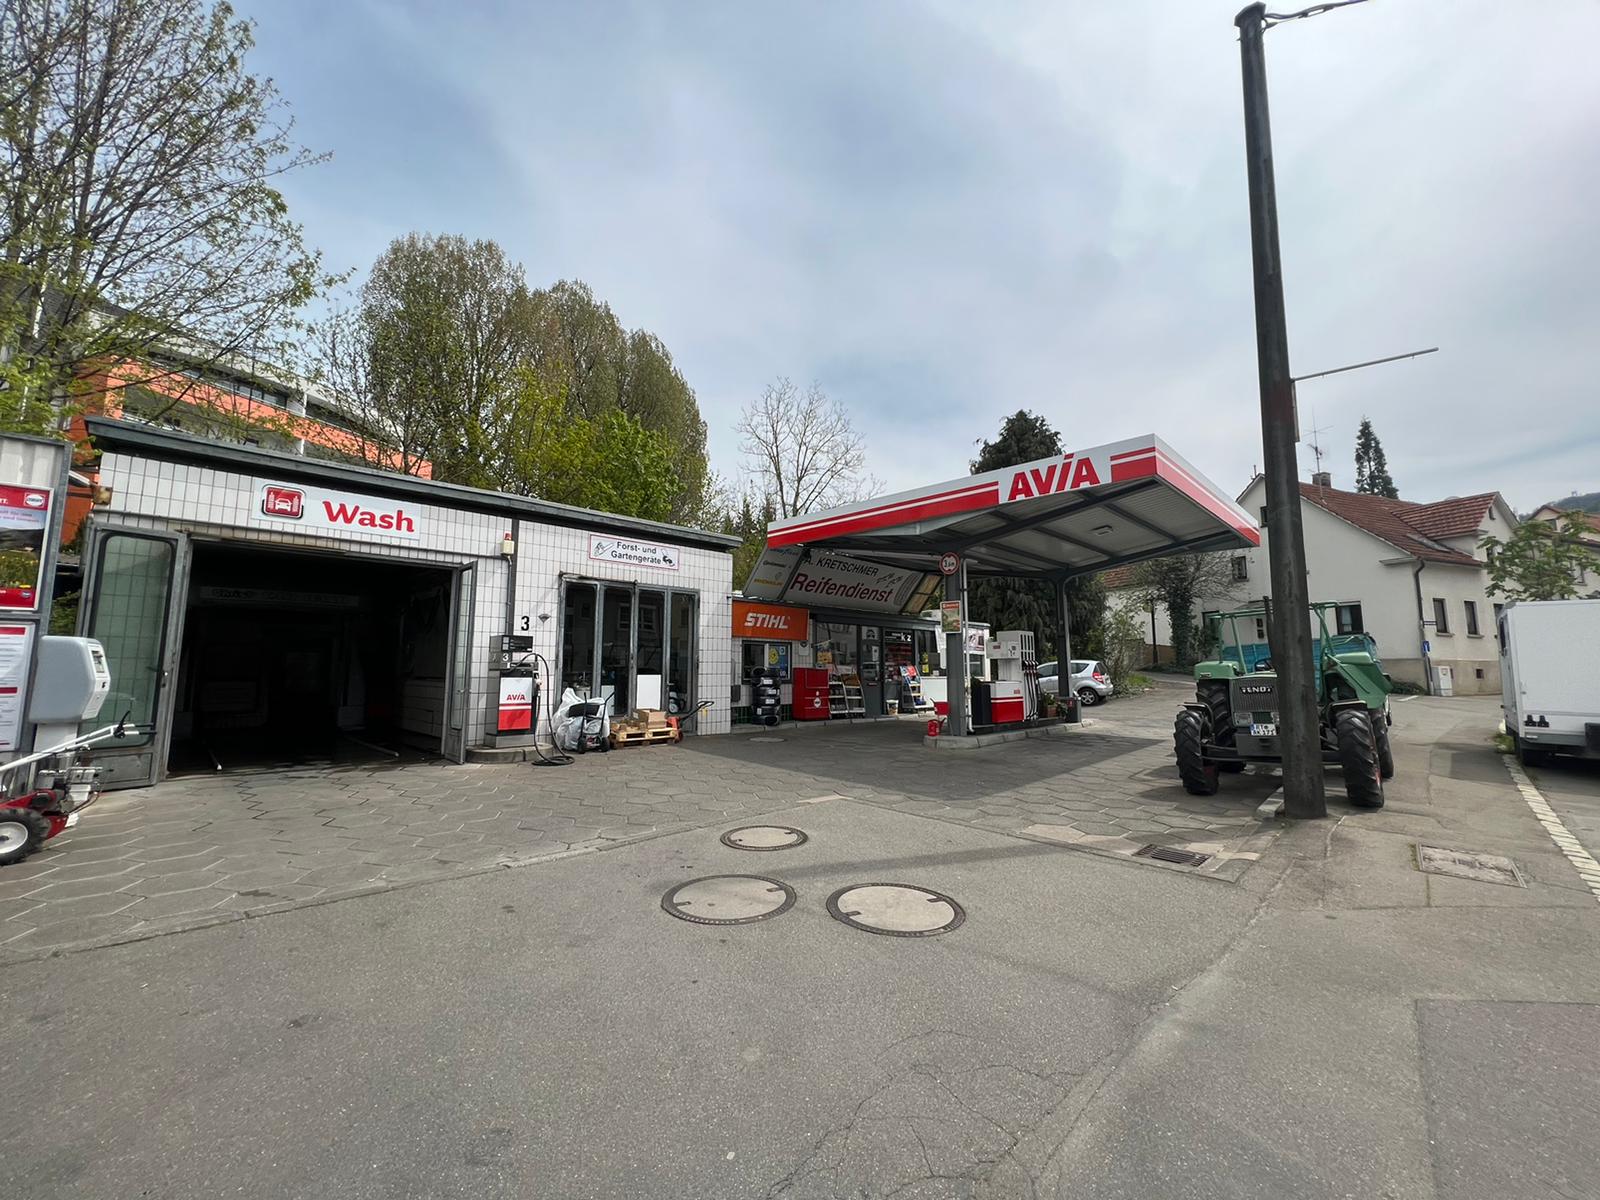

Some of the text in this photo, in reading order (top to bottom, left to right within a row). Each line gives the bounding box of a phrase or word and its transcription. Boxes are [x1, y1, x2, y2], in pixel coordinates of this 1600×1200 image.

[1008, 453, 1101, 501] AVIA
[322, 500, 415, 533] Wash
[616, 541, 657, 554] Forst- und
[816, 557, 879, 577] KRETSCHMER
[790, 572, 894, 602] Reifendienst
[521, 616, 530, 631] 3
[744, 612, 789, 629] STIHL
[502, 653, 509, 662] 3
